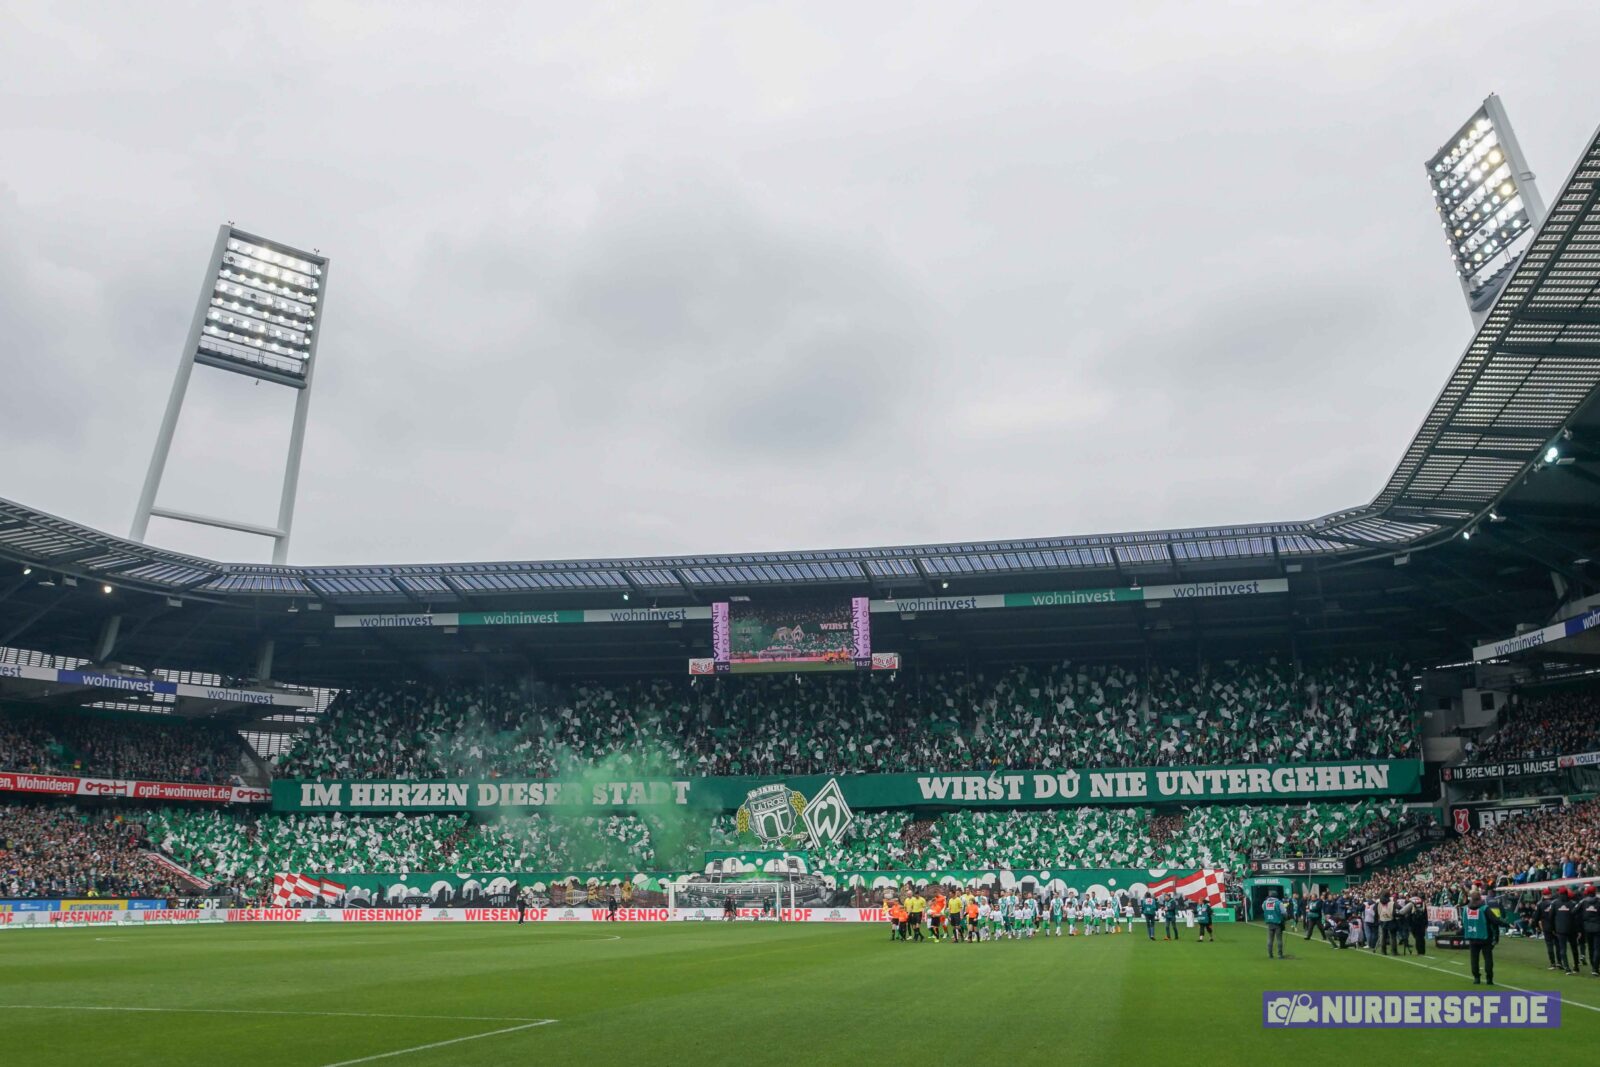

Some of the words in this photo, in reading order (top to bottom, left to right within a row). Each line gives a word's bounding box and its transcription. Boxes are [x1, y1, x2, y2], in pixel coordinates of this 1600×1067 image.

[1173, 581, 1259, 598] wohninvest
[896, 596, 977, 611] wohninvest
[1032, 589, 1116, 606] wohninvest
[360, 614, 433, 626] wohninvest
[483, 611, 559, 625] wohninvest
[610, 608, 687, 621] wohninvest
[1494, 629, 1545, 657] wohninvest
[82, 674, 155, 692] wohninvest
[207, 688, 274, 705] wohninvest
[1465, 766, 1504, 779] BREMEN
[1507, 764, 1520, 775] ZU
[1523, 760, 1556, 774] HAUSE
[17, 776, 75, 792] Wohnideen
[917, 774, 1024, 800] WIRST
[1089, 771, 1148, 798] NIE
[1156, 764, 1390, 796] UNTERGEHEN
[139, 784, 231, 799] opti-wohnwelt.de
[300, 783, 342, 806] IM
[350, 783, 469, 806] HERZEN
[477, 782, 583, 806] DIESER
[592, 781, 691, 805] STADT
[1261, 862, 1295, 870] BECK'S
[1309, 861, 1344, 870] BECK'S
[50, 910, 113, 923] WIESENHOF
[144, 909, 200, 921] WIESENHOF
[227, 909, 302, 921] WIESENHOF
[342, 909, 423, 921] WIESENHOF
[465, 908, 548, 921] WIESENHOF
